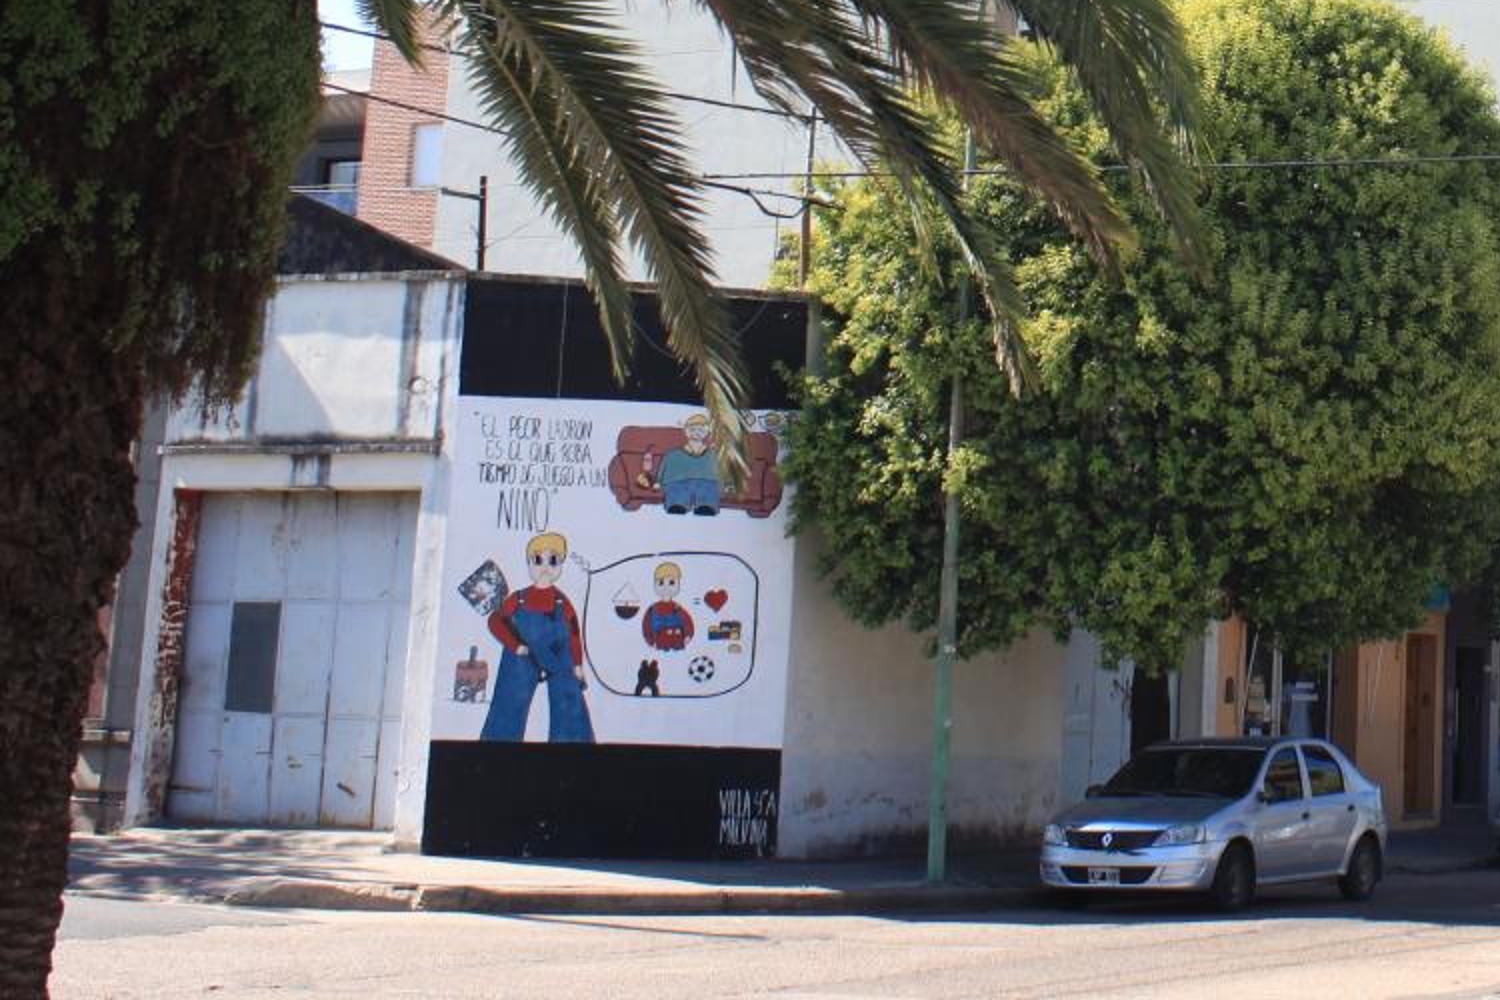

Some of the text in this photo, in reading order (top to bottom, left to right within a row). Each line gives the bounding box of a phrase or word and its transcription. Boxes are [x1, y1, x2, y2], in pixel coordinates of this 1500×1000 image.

[509, 415, 541, 440] PEOR
[485, 440, 503, 460] ES
[529, 442, 556, 463] QUE
[479, 462, 517, 485] TIEMPO
[538, 464, 575, 487] JUEGO
[577, 466, 587, 487] A
[590, 467, 607, 488] UN
